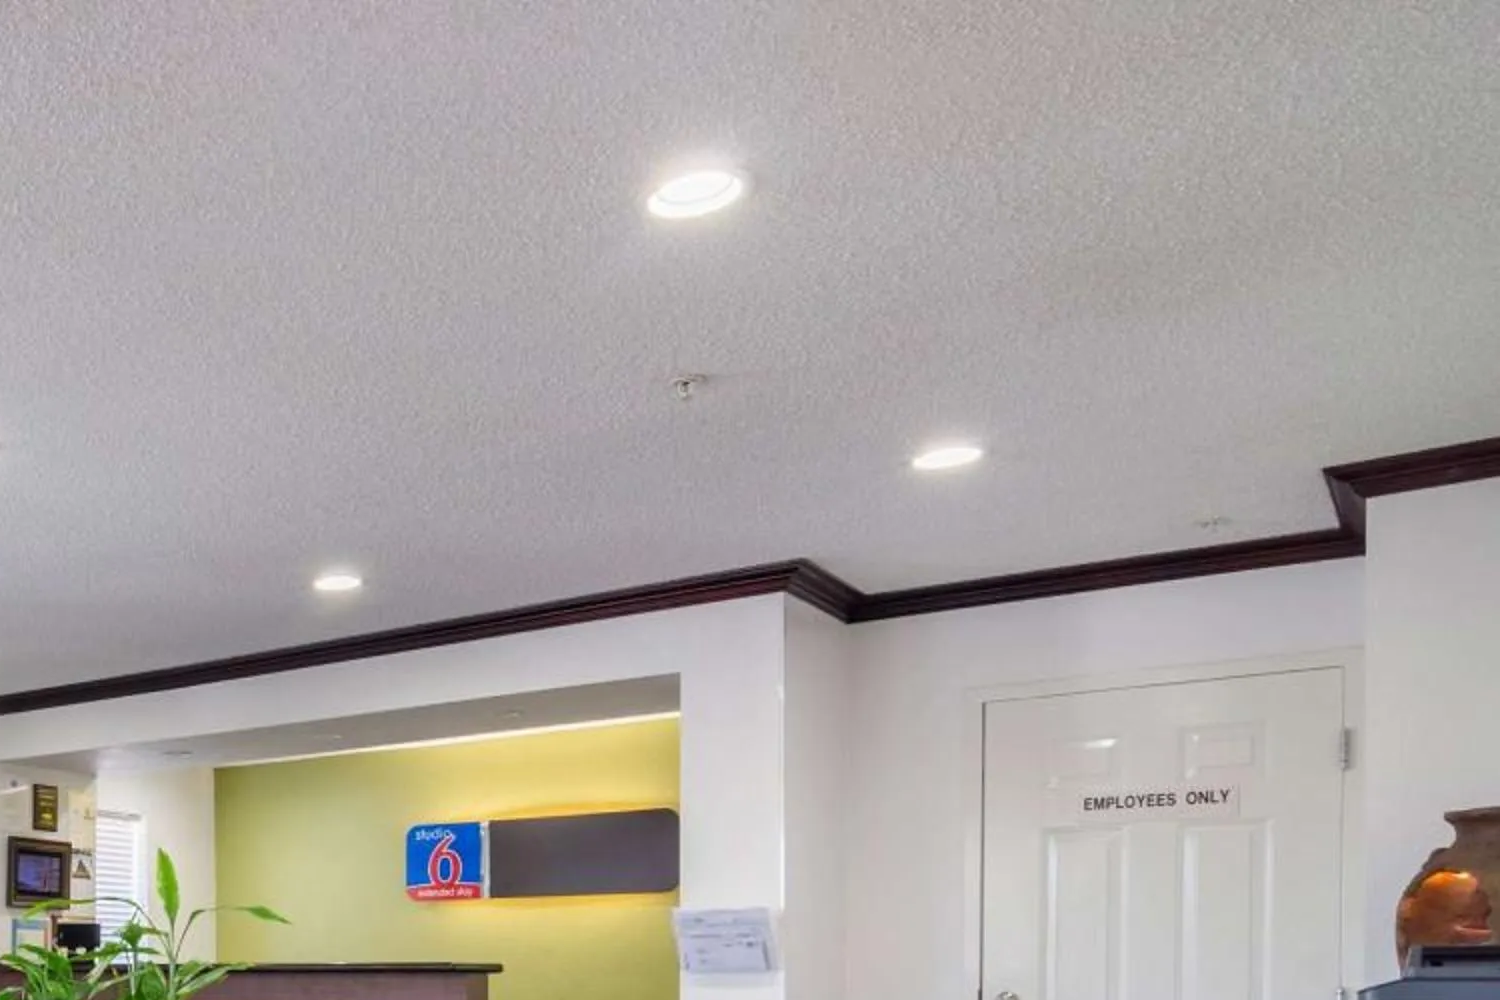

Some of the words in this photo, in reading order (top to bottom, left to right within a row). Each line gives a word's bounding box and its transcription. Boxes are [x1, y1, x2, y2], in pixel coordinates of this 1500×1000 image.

[1083, 793, 1177, 811] EMPLOYEES
[1185, 789, 1230, 805] ONLY
[427, 834, 463, 885] 6
